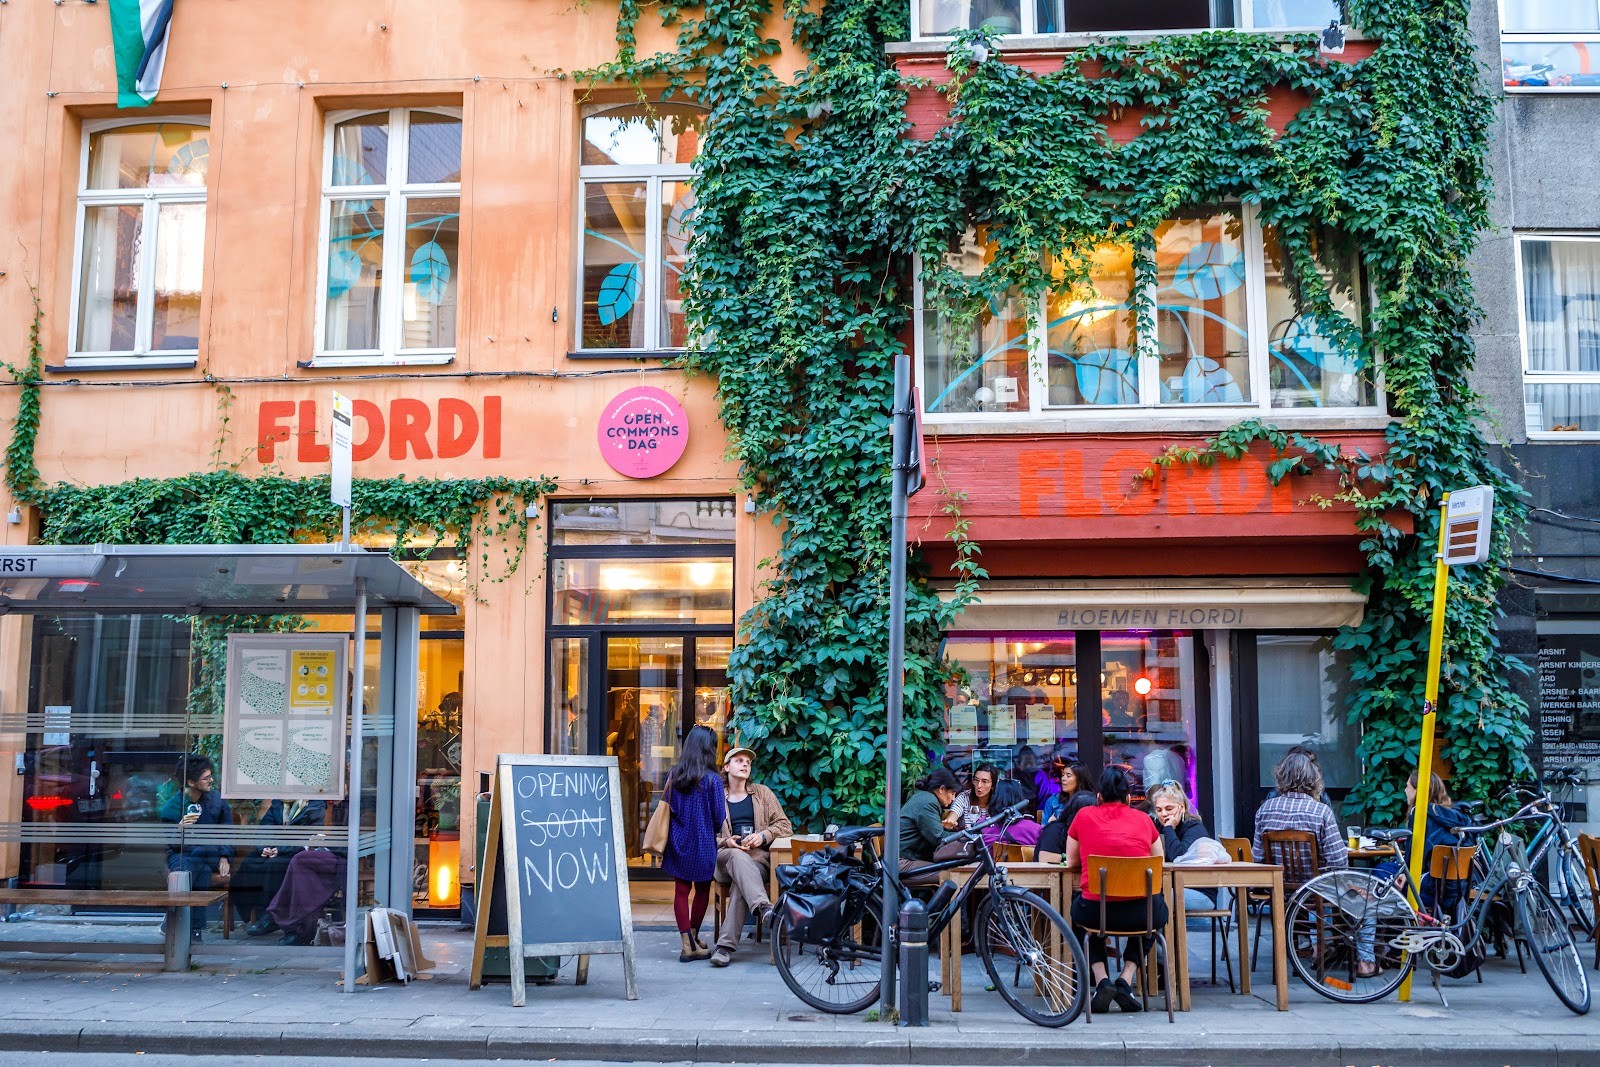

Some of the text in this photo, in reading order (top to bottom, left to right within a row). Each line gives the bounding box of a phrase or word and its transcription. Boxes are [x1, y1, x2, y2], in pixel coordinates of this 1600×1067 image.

[257, 395, 502, 463] FLORDI
[607, 425, 679, 438] COMMONS
[624, 413, 662, 424] OPEN
[628, 439, 657, 449] DAG
[1019, 449, 1292, 518] FLORDI
[1057, 607, 1244, 627] BLOEMEN FLORDI
[517, 772, 609, 801] OPENING
[521, 806, 607, 847] SOON
[524, 842, 609, 897] NOW
